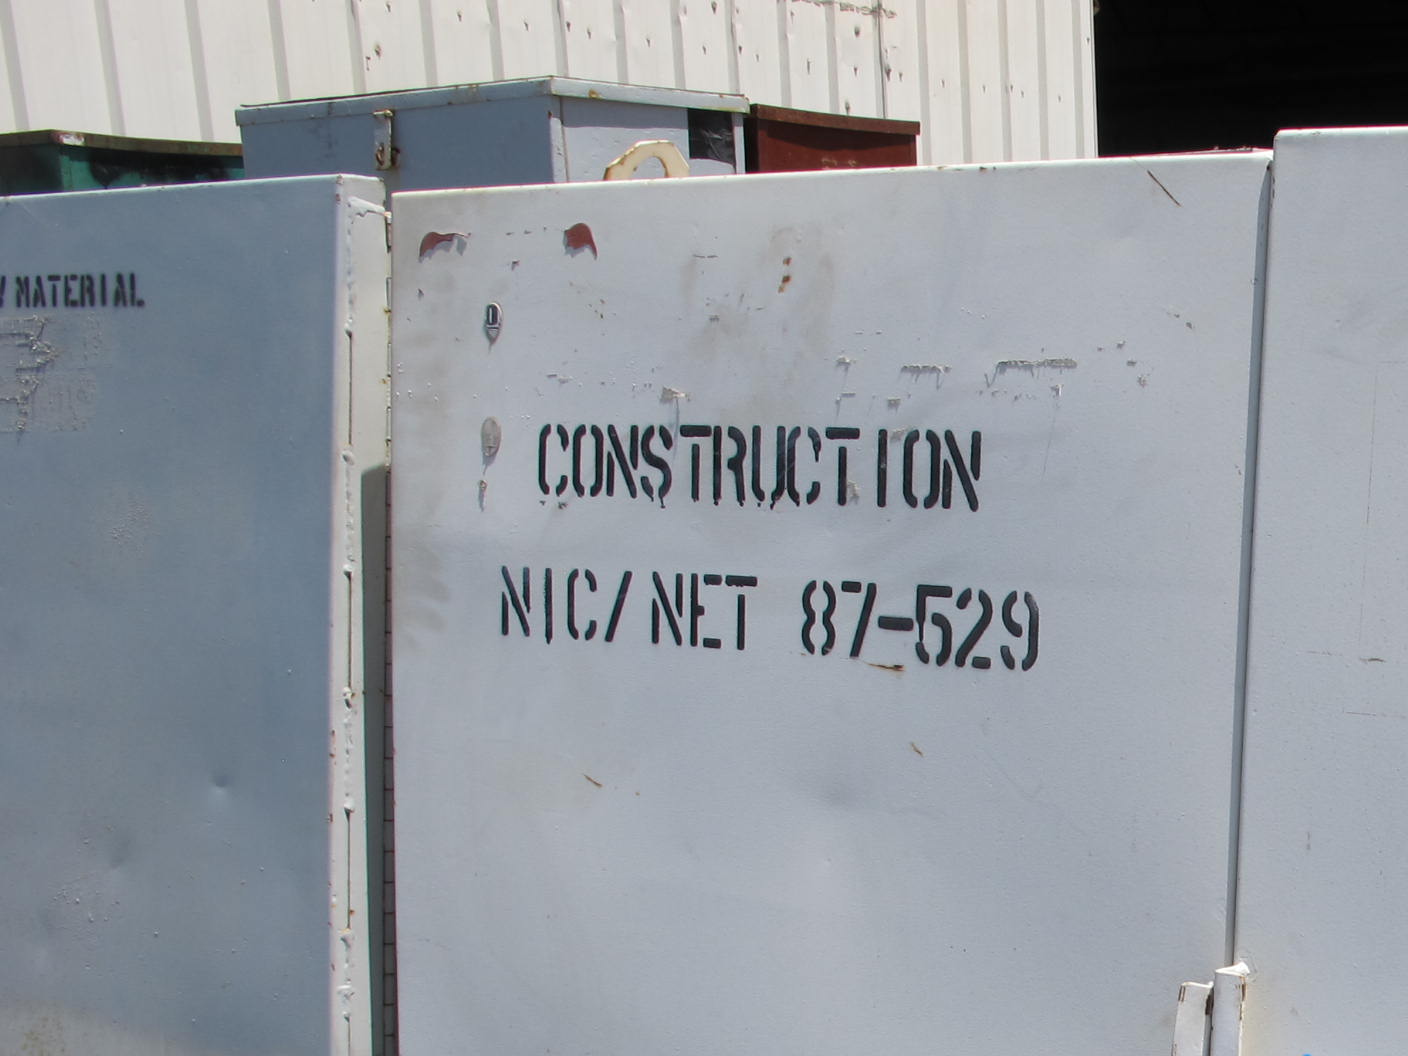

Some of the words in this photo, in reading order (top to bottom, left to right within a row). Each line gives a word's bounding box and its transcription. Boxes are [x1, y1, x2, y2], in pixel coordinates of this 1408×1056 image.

[15, 272, 145, 308] MATERIAL
[537, 423, 982, 512] CONSTRUCTION
[800, 579, 1040, 672] 87-529
